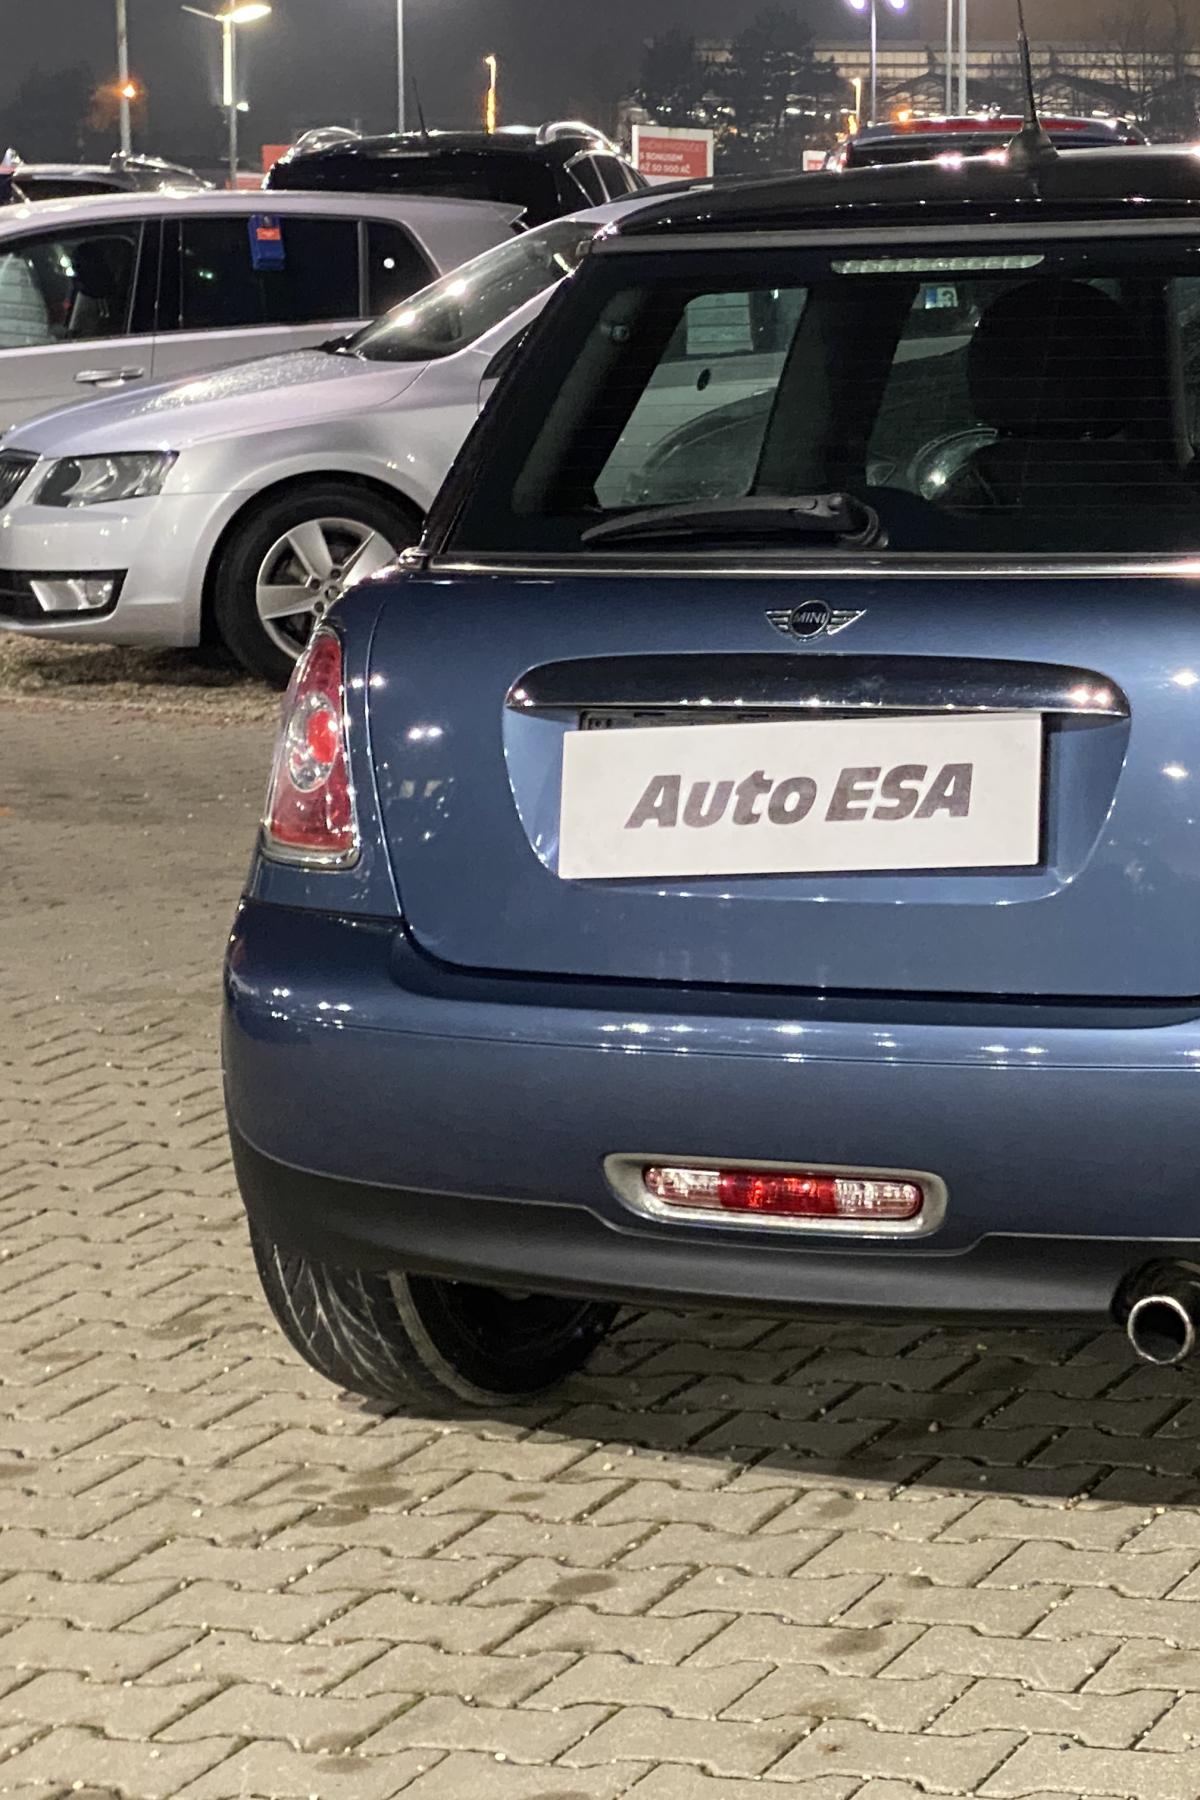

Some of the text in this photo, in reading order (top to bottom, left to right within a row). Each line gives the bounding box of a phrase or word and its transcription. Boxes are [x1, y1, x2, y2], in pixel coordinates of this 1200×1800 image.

[793, 612, 827, 623] MINI
[624, 763, 973, 828] Auto ESA
